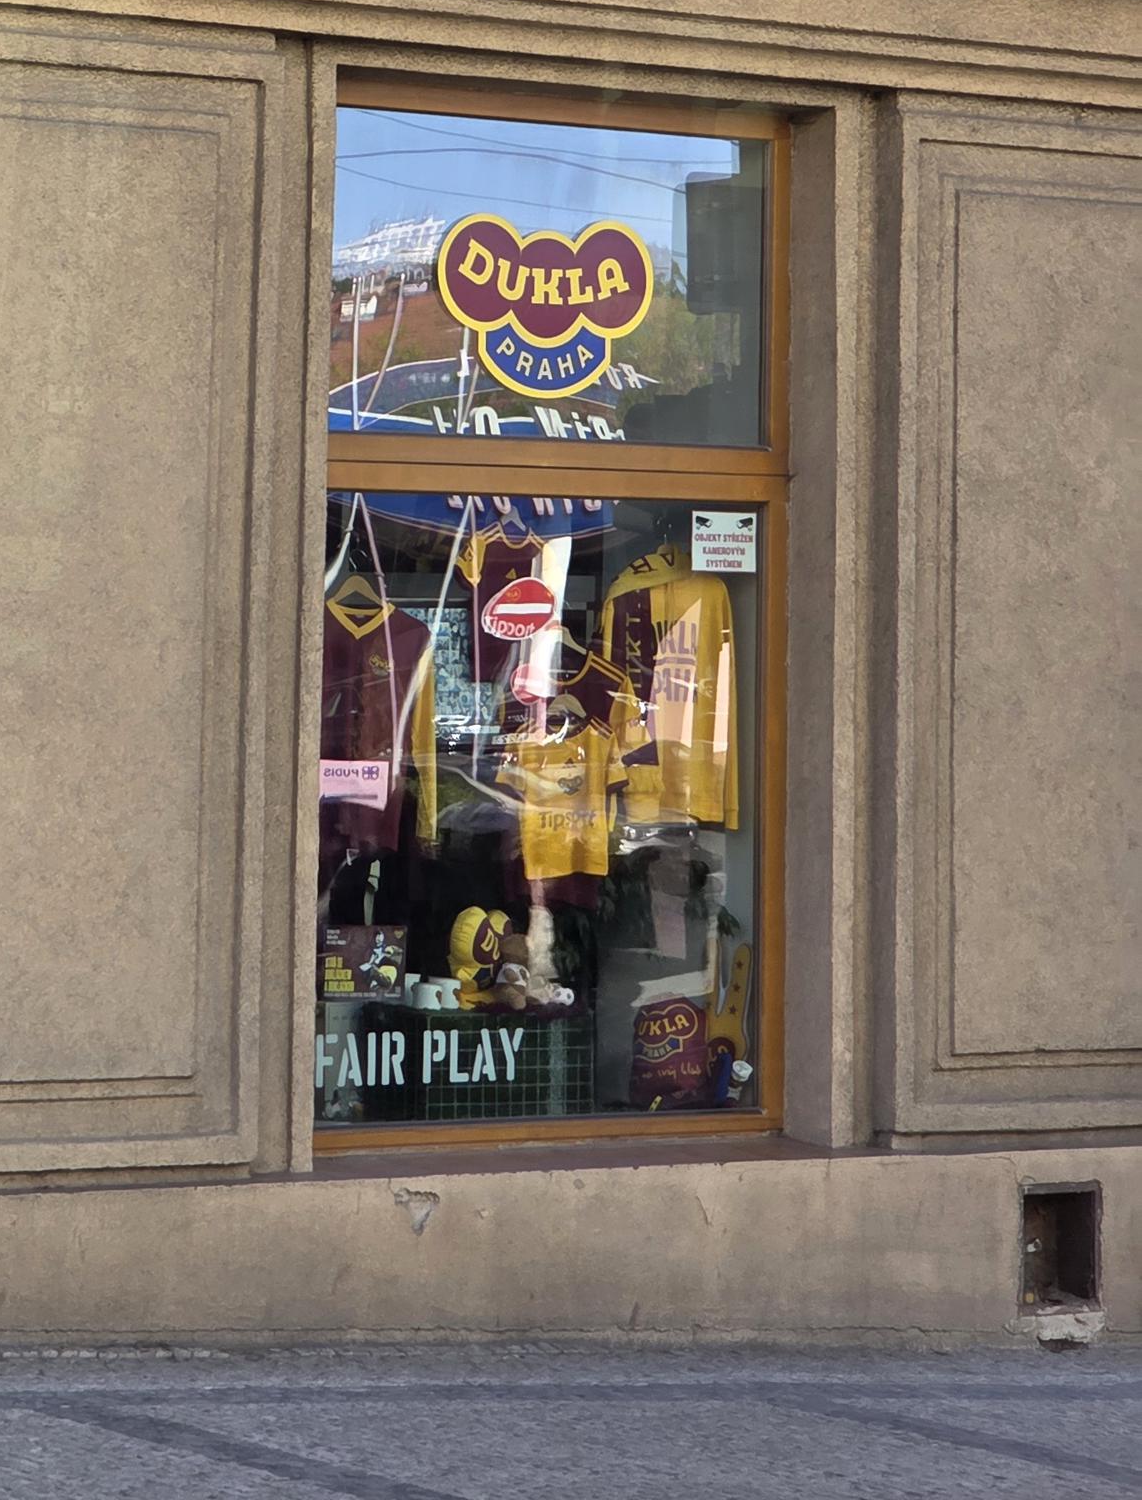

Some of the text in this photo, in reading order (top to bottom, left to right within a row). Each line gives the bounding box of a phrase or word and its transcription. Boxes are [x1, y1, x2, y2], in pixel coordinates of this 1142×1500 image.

[457, 237, 632, 306] DUKLA
[495, 336, 595, 382] PRAHA
[694, 532, 721, 543] OBJEKT
[314, 1027, 525, 1088] FAIR PLAY
